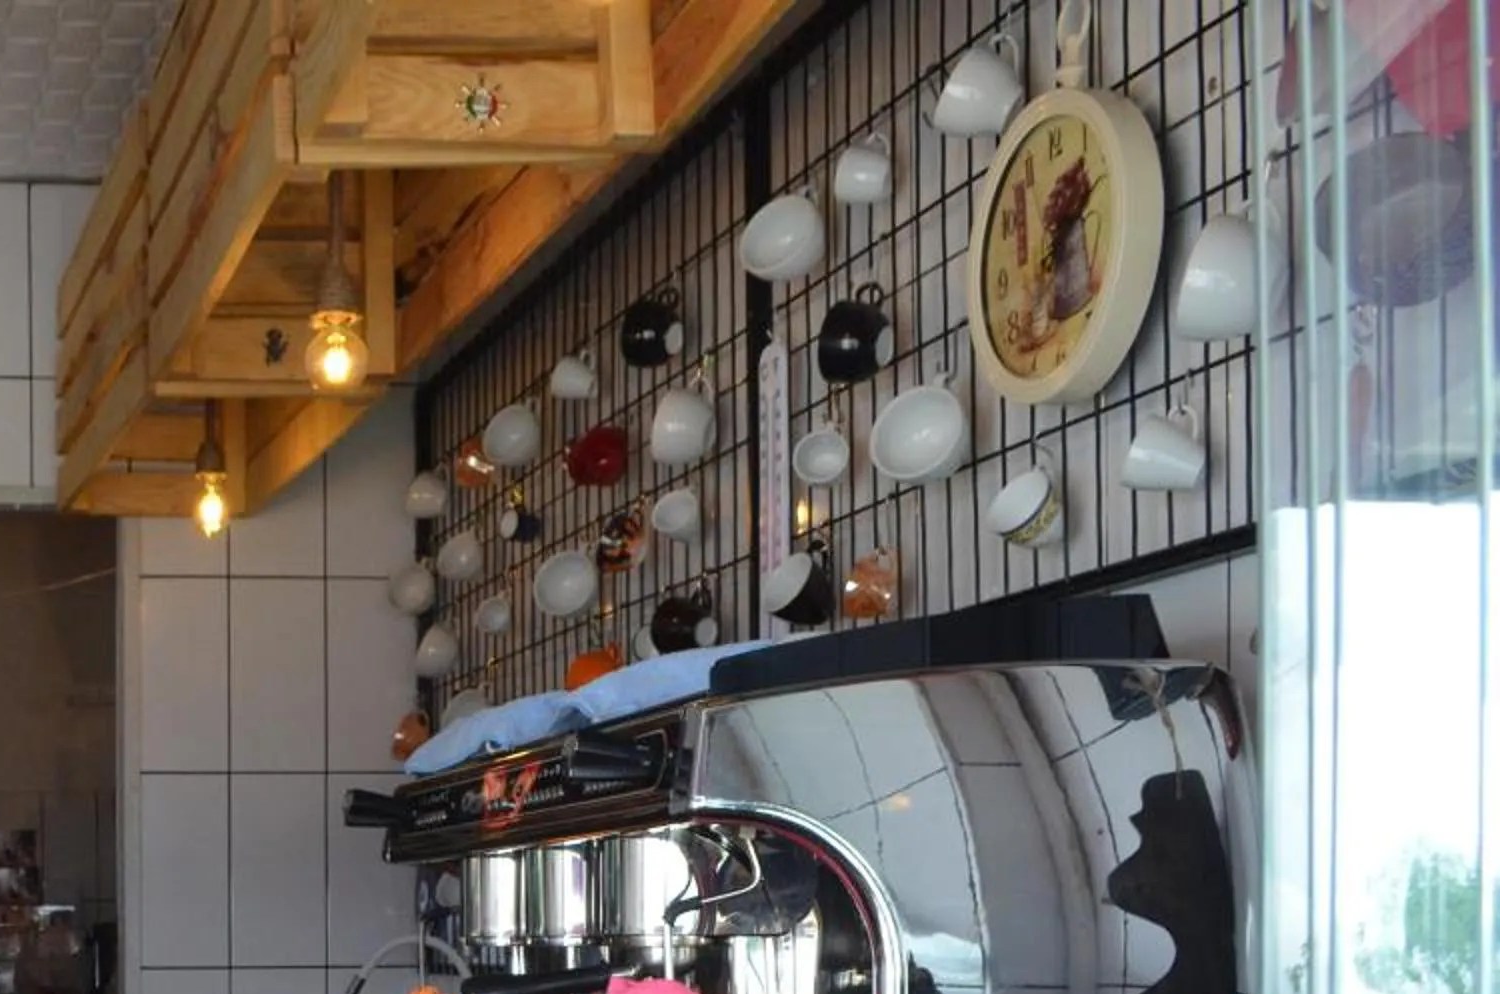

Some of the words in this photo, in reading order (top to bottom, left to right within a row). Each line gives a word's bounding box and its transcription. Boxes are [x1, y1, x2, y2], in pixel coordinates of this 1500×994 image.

[1002, 207, 1017, 241] 10
[997, 267, 1009, 301] 9
[1007, 309, 1019, 344] 8
